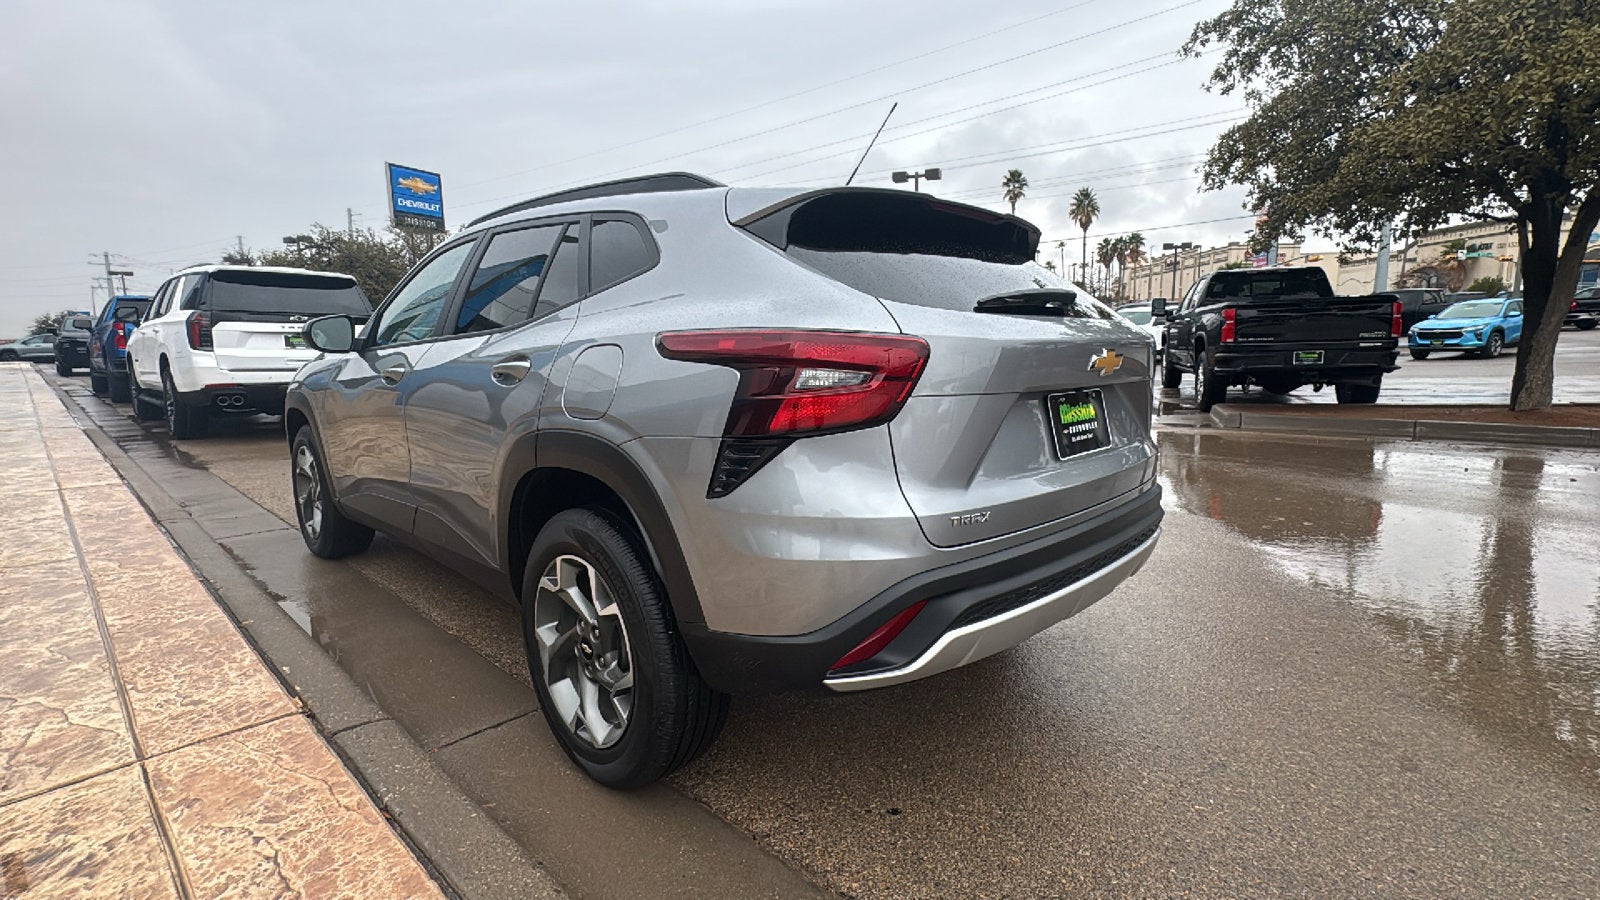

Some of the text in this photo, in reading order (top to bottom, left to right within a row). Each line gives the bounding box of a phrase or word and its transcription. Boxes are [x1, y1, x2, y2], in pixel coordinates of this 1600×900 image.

[397, 197, 440, 212] CHEVROLET
[1059, 402, 1096, 424] Mission
[950, 511, 991, 527] TRAX
